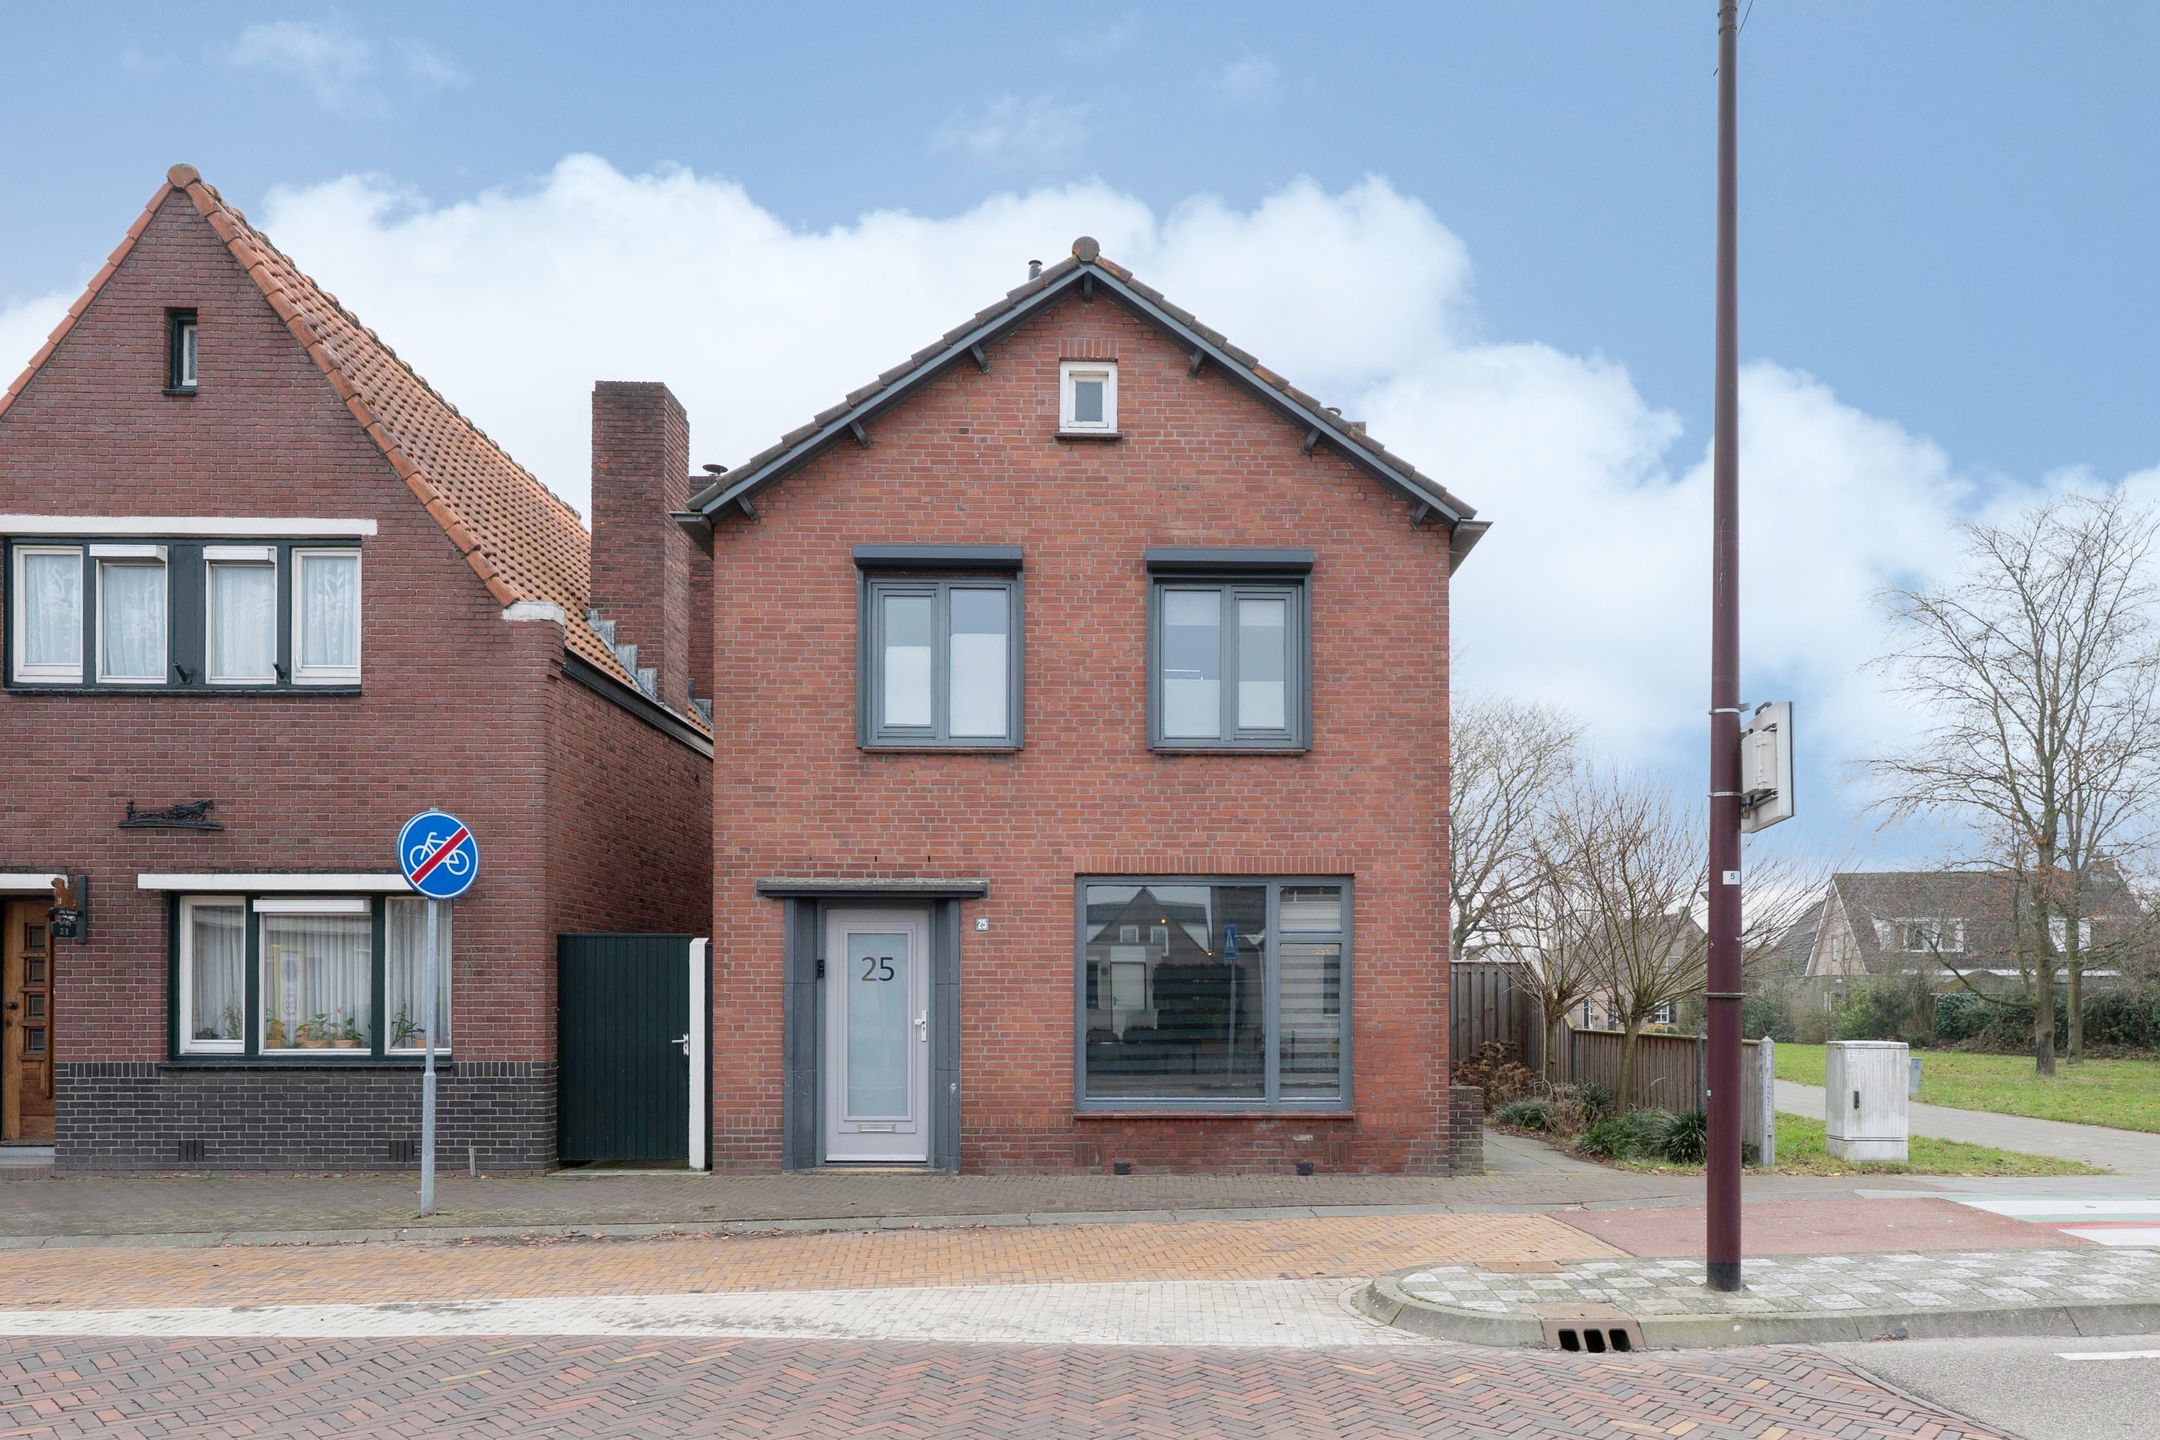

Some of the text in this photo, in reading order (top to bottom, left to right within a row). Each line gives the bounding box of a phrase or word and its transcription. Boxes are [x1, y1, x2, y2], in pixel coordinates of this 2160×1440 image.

[1730, 872, 1736, 880] 5
[977, 918, 987, 929] 25
[861, 956, 895, 982] 25
